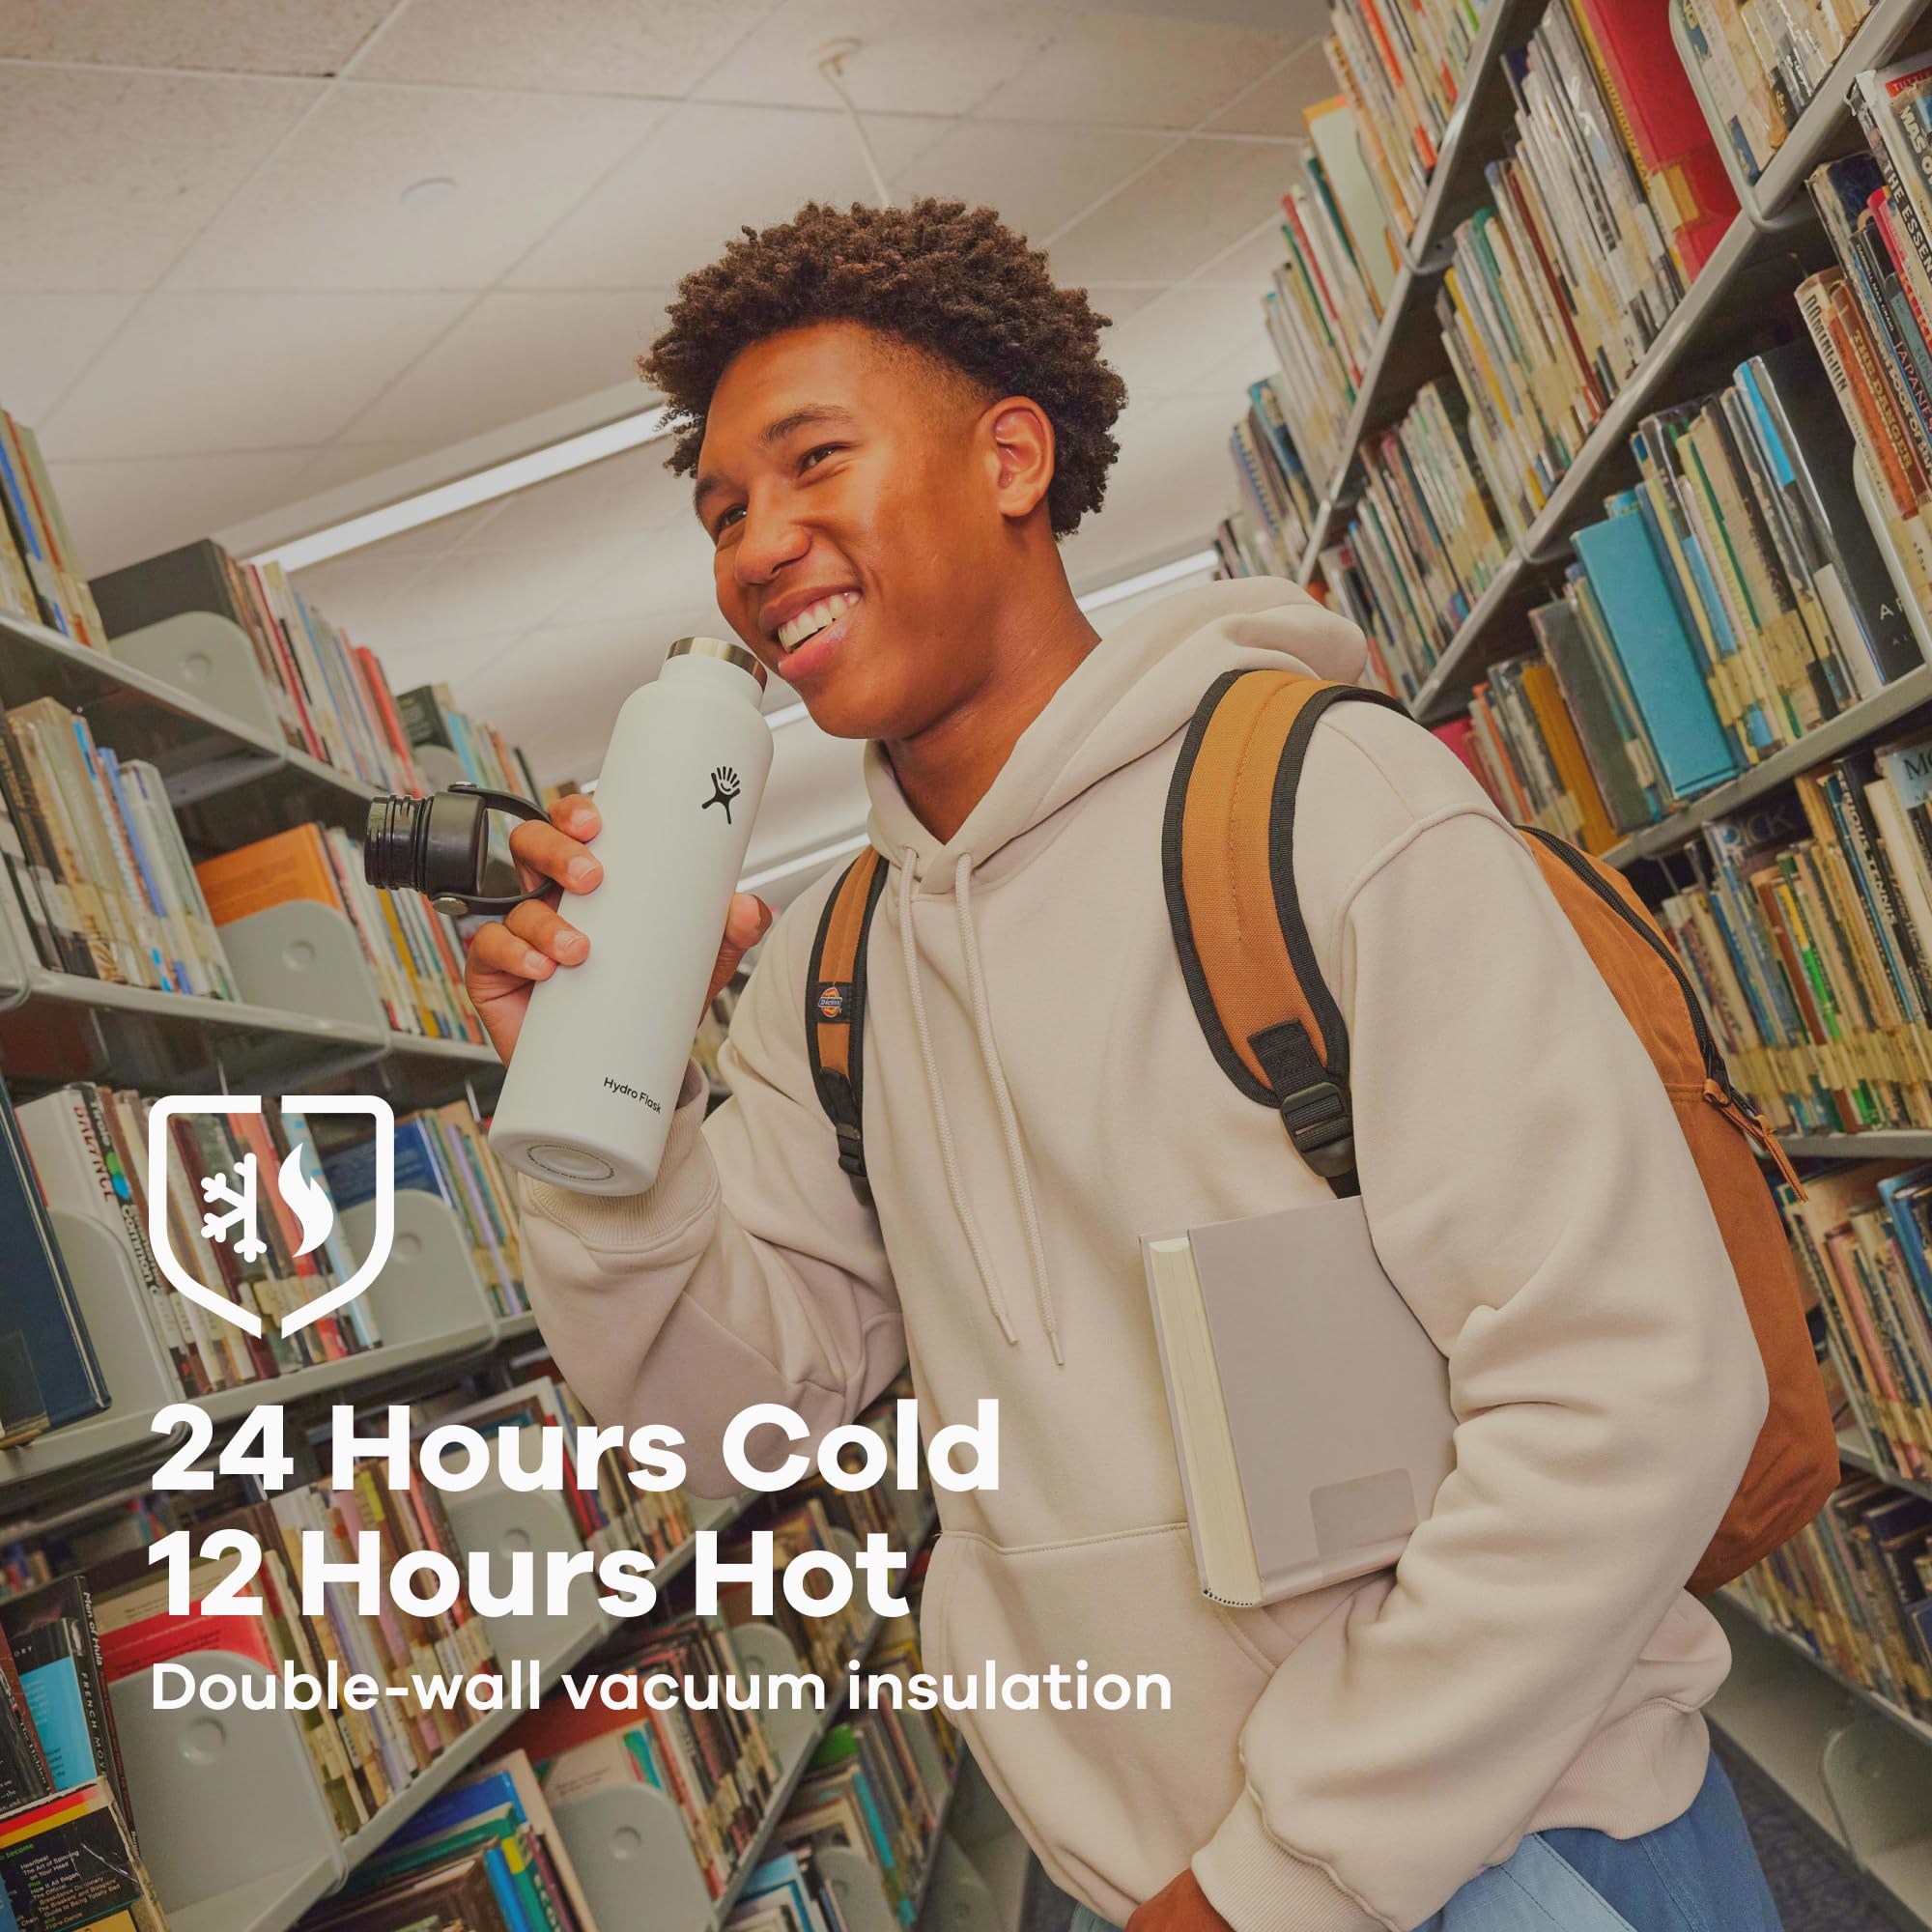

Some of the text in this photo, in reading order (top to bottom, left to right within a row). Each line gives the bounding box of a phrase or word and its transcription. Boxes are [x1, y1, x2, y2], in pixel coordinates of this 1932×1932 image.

[1899, 105, 1926, 155] MAS
[1883, 160, 1905, 204] THE
[1900, 206, 1932, 282] ESSEN
[1872, 283, 1883, 302] MAX
[1881, 304, 1894, 331] CRAIG
[1854, 330, 1876, 376] THE
[1872, 380, 1915, 468] DANGER
[1866, 855, 1897, 925] TENNIS
[604, 1077, 662, 1115] Hydro Flask
[83, 1591, 103, 1665] Men of Hula
[80, 1672, 99, 1729] FRENCH
[6, 1843, 34, 1858] become
[20, 1856, 48, 1868] Heartbeat
[39, 1867, 52, 1876] Your
[53, 1861, 69, 1871] Head
[53, 1850, 80, 1864] Spinning
[30, 1886, 43, 1894] How
[20, 1916, 39, 1926] Chain
